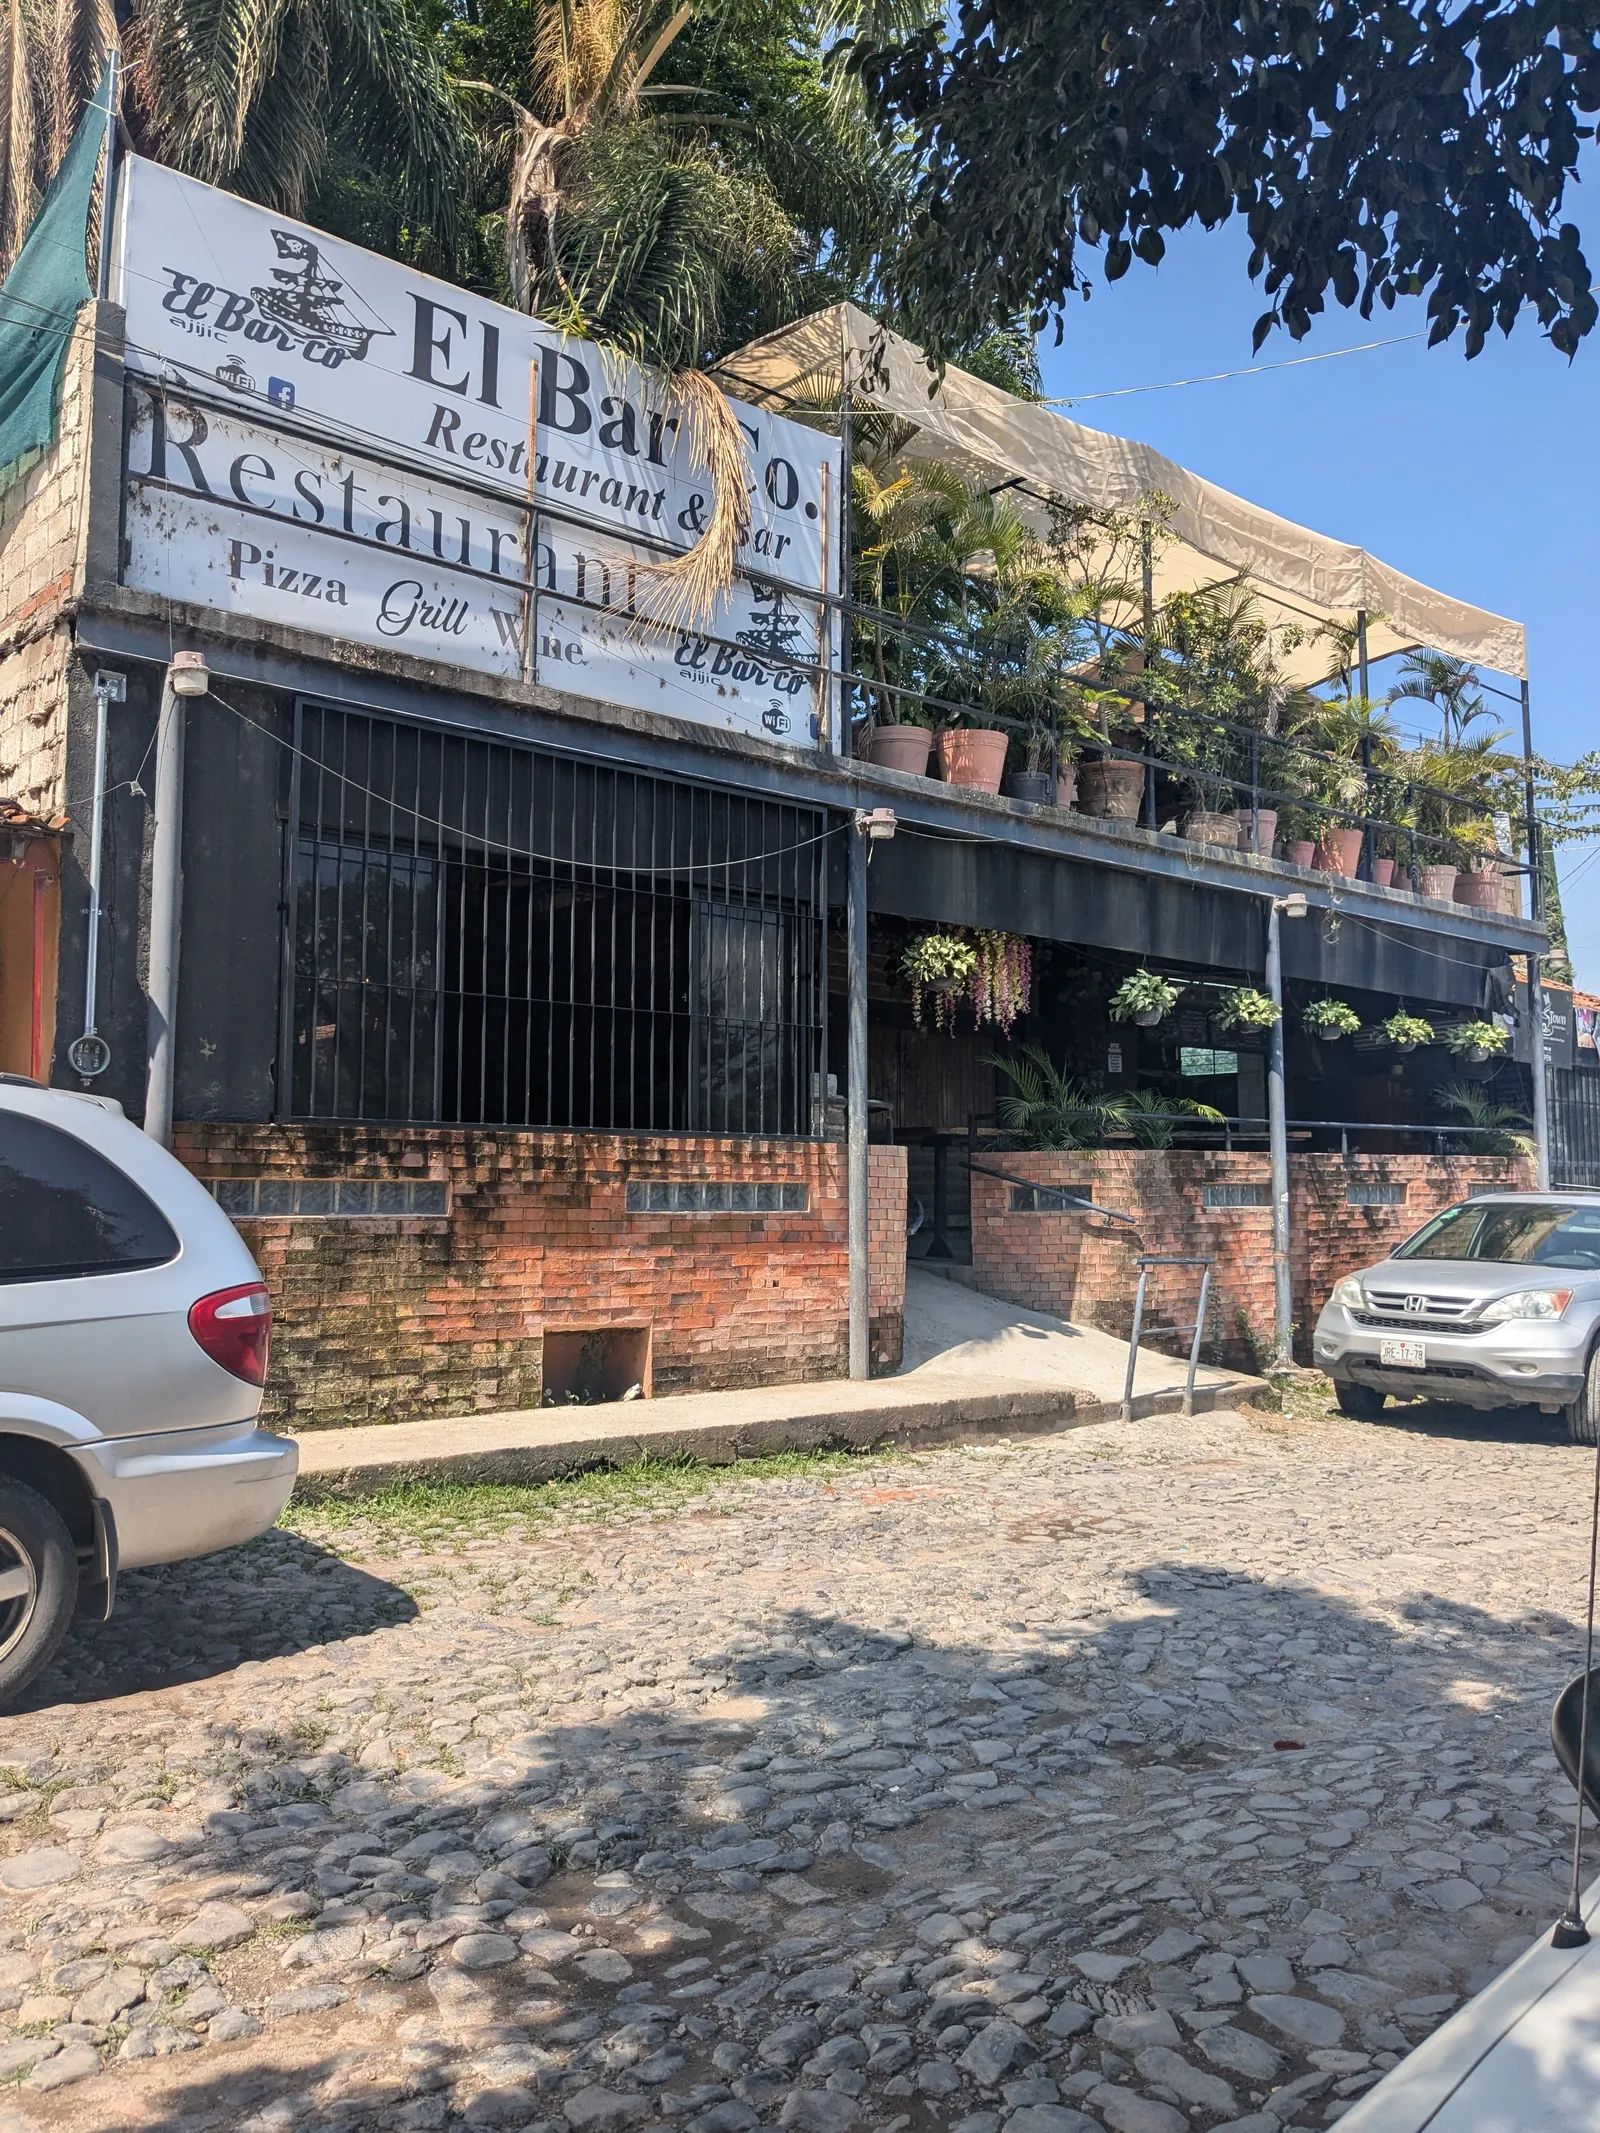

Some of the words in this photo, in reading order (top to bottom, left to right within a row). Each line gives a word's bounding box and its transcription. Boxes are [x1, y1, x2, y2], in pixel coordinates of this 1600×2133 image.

[162, 266, 216, 320] El
[169, 315, 229, 344] ajijic
[402, 290, 503, 410] El
[537, 342, 679, 469] Bar
[420, 402, 667, 521] Restaurant
[677, 493, 708, 537] &
[226, 537, 349, 606] Pizza
[375, 579, 470, 638] Grill
[488, 606, 584, 666] Wne
[679, 668, 722, 687] ajijic
